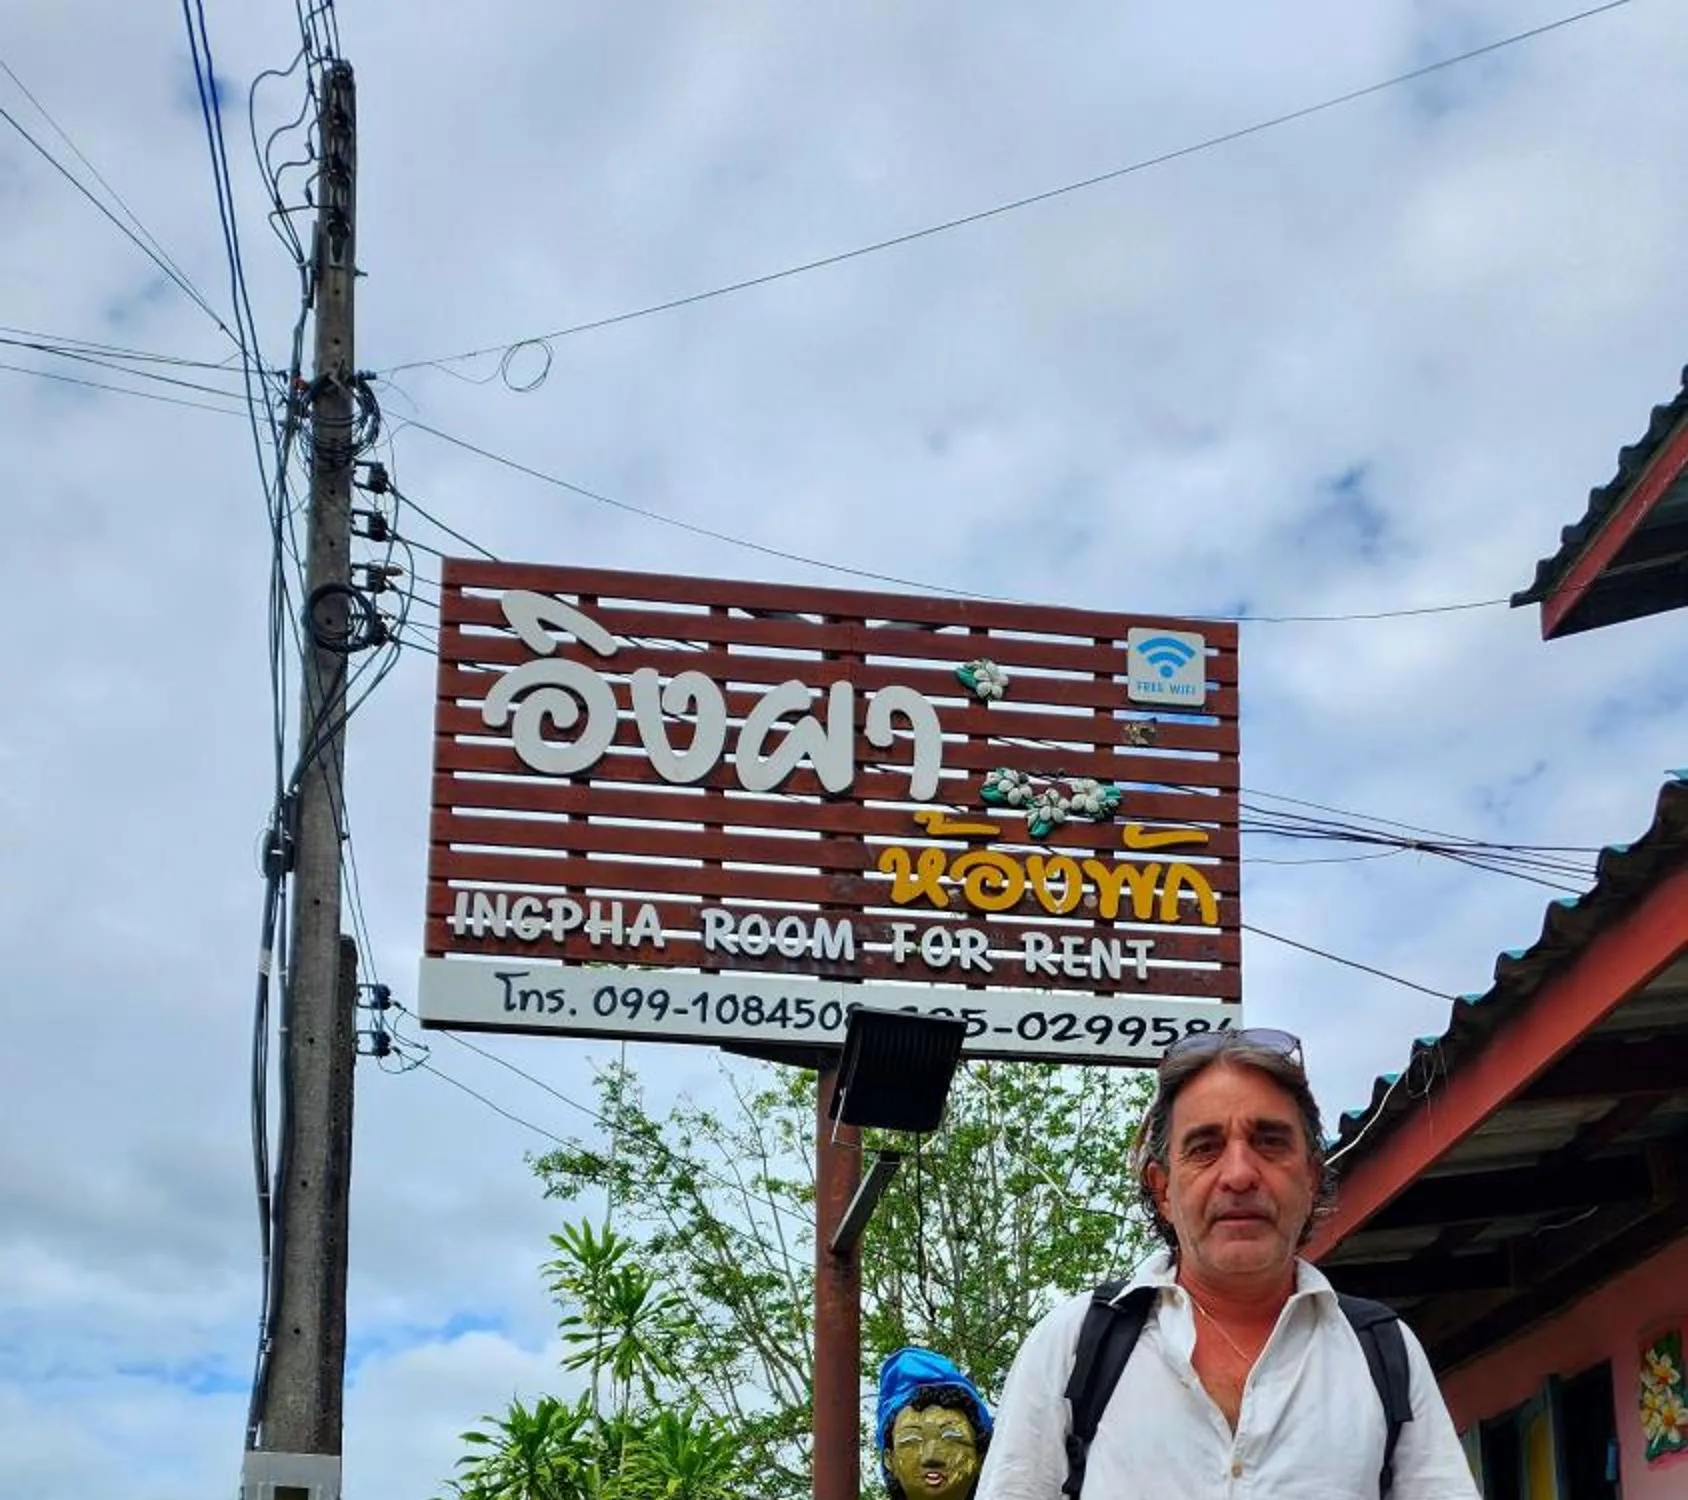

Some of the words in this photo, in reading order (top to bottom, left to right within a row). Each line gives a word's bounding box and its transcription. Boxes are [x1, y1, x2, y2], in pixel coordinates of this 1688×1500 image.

[482, 589, 943, 801] อิงผา
[1136, 681, 1164, 693] FREE
[878, 810, 1219, 925] ห้องพัก
[452, 891, 666, 949] INGPHA
[701, 908, 855, 962] ROOM
[891, 922, 993, 973] FOR
[1021, 931, 1156, 980] RENT
[494, 971, 577, 1016] โทร.
